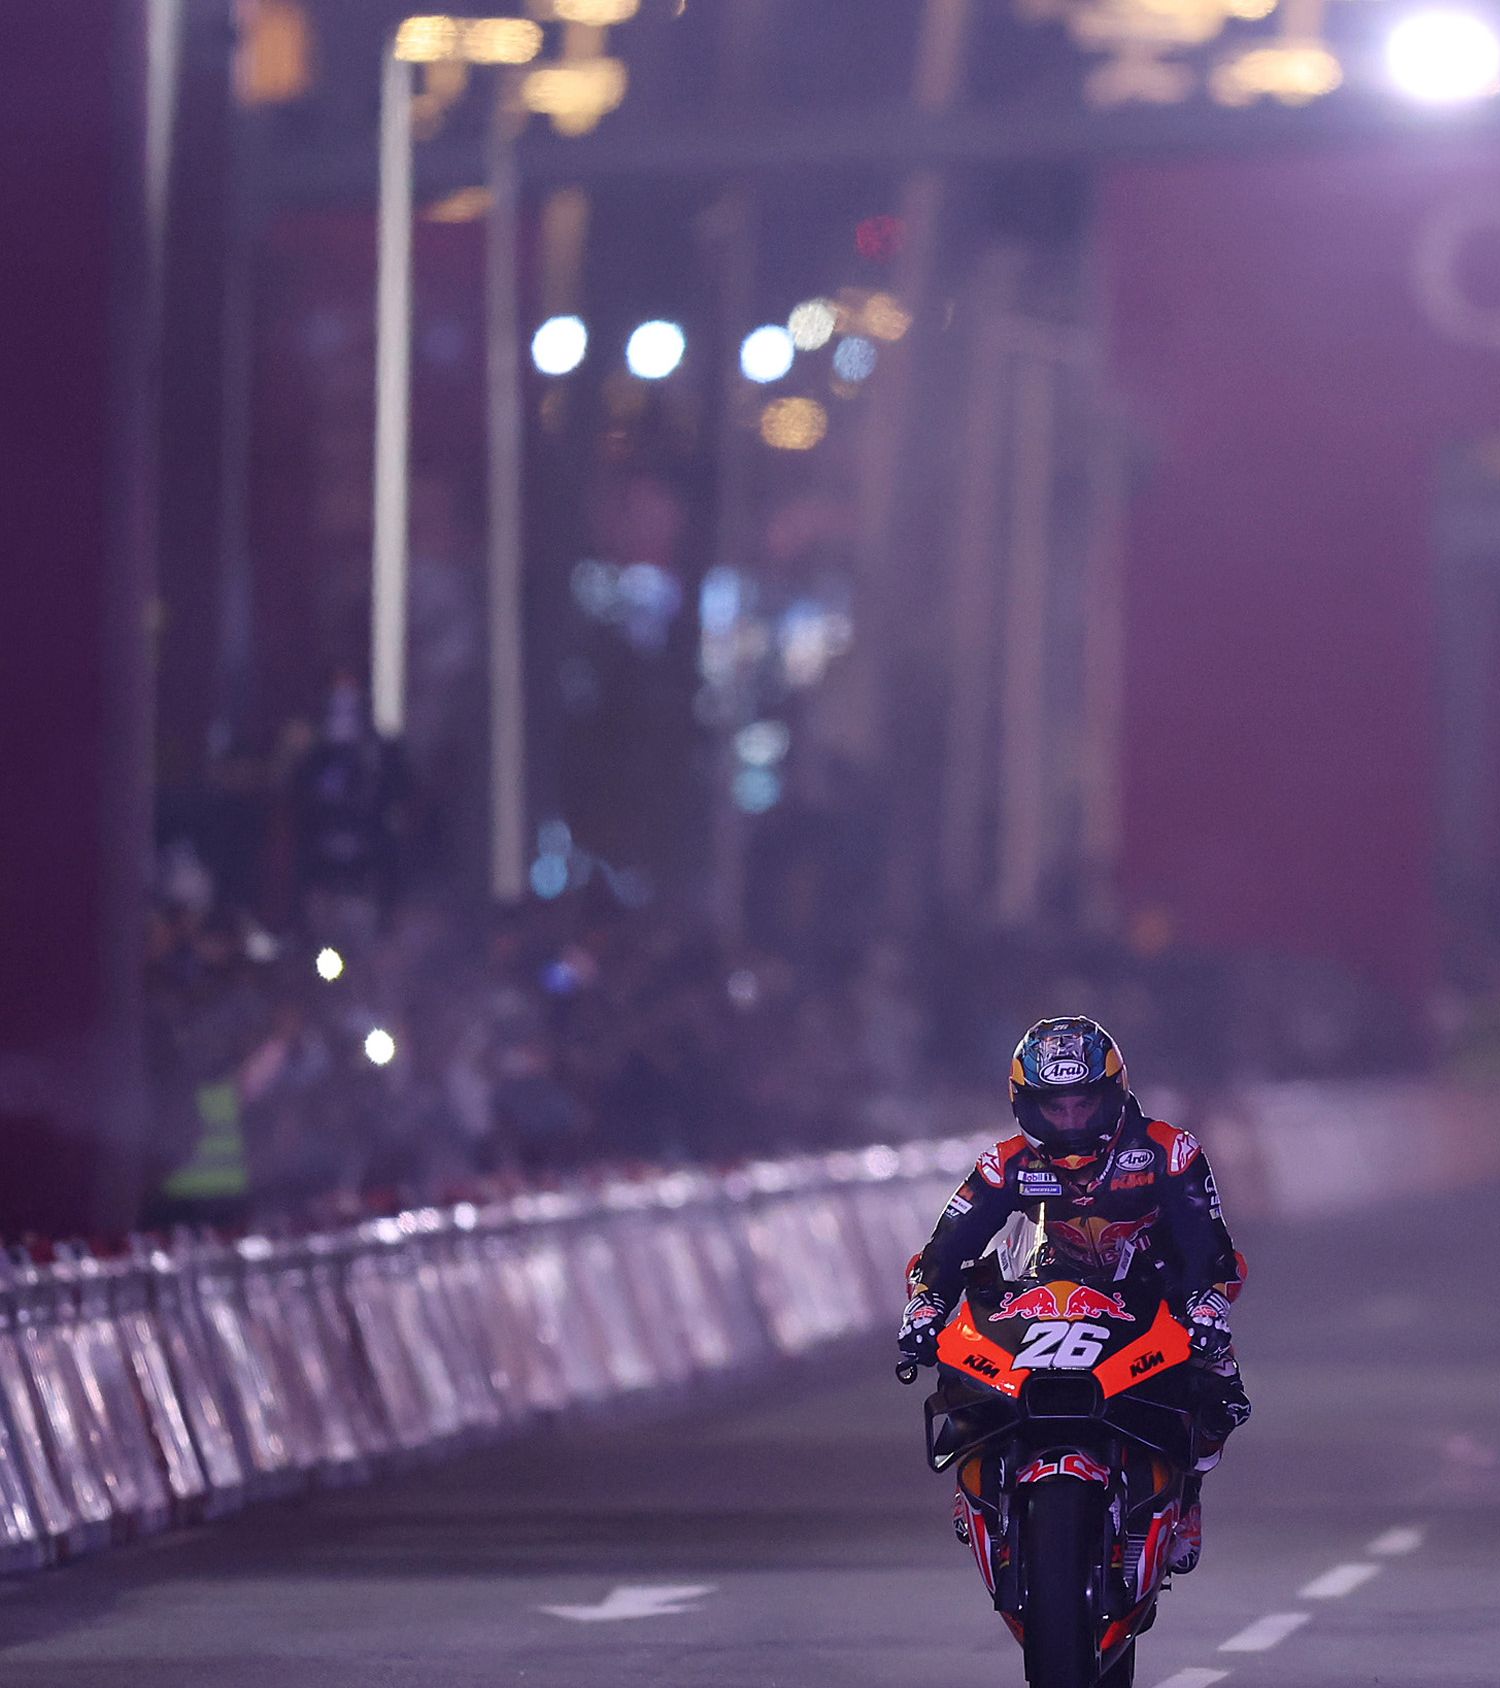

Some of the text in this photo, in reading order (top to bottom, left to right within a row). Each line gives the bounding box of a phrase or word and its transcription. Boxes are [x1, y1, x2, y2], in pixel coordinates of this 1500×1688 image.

[1044, 1063, 1081, 1079] Arai
[1011, 1321, 1111, 1370] 26
[962, 1353, 1000, 1379] KTM
[1130, 1351, 1165, 1379] KTM
